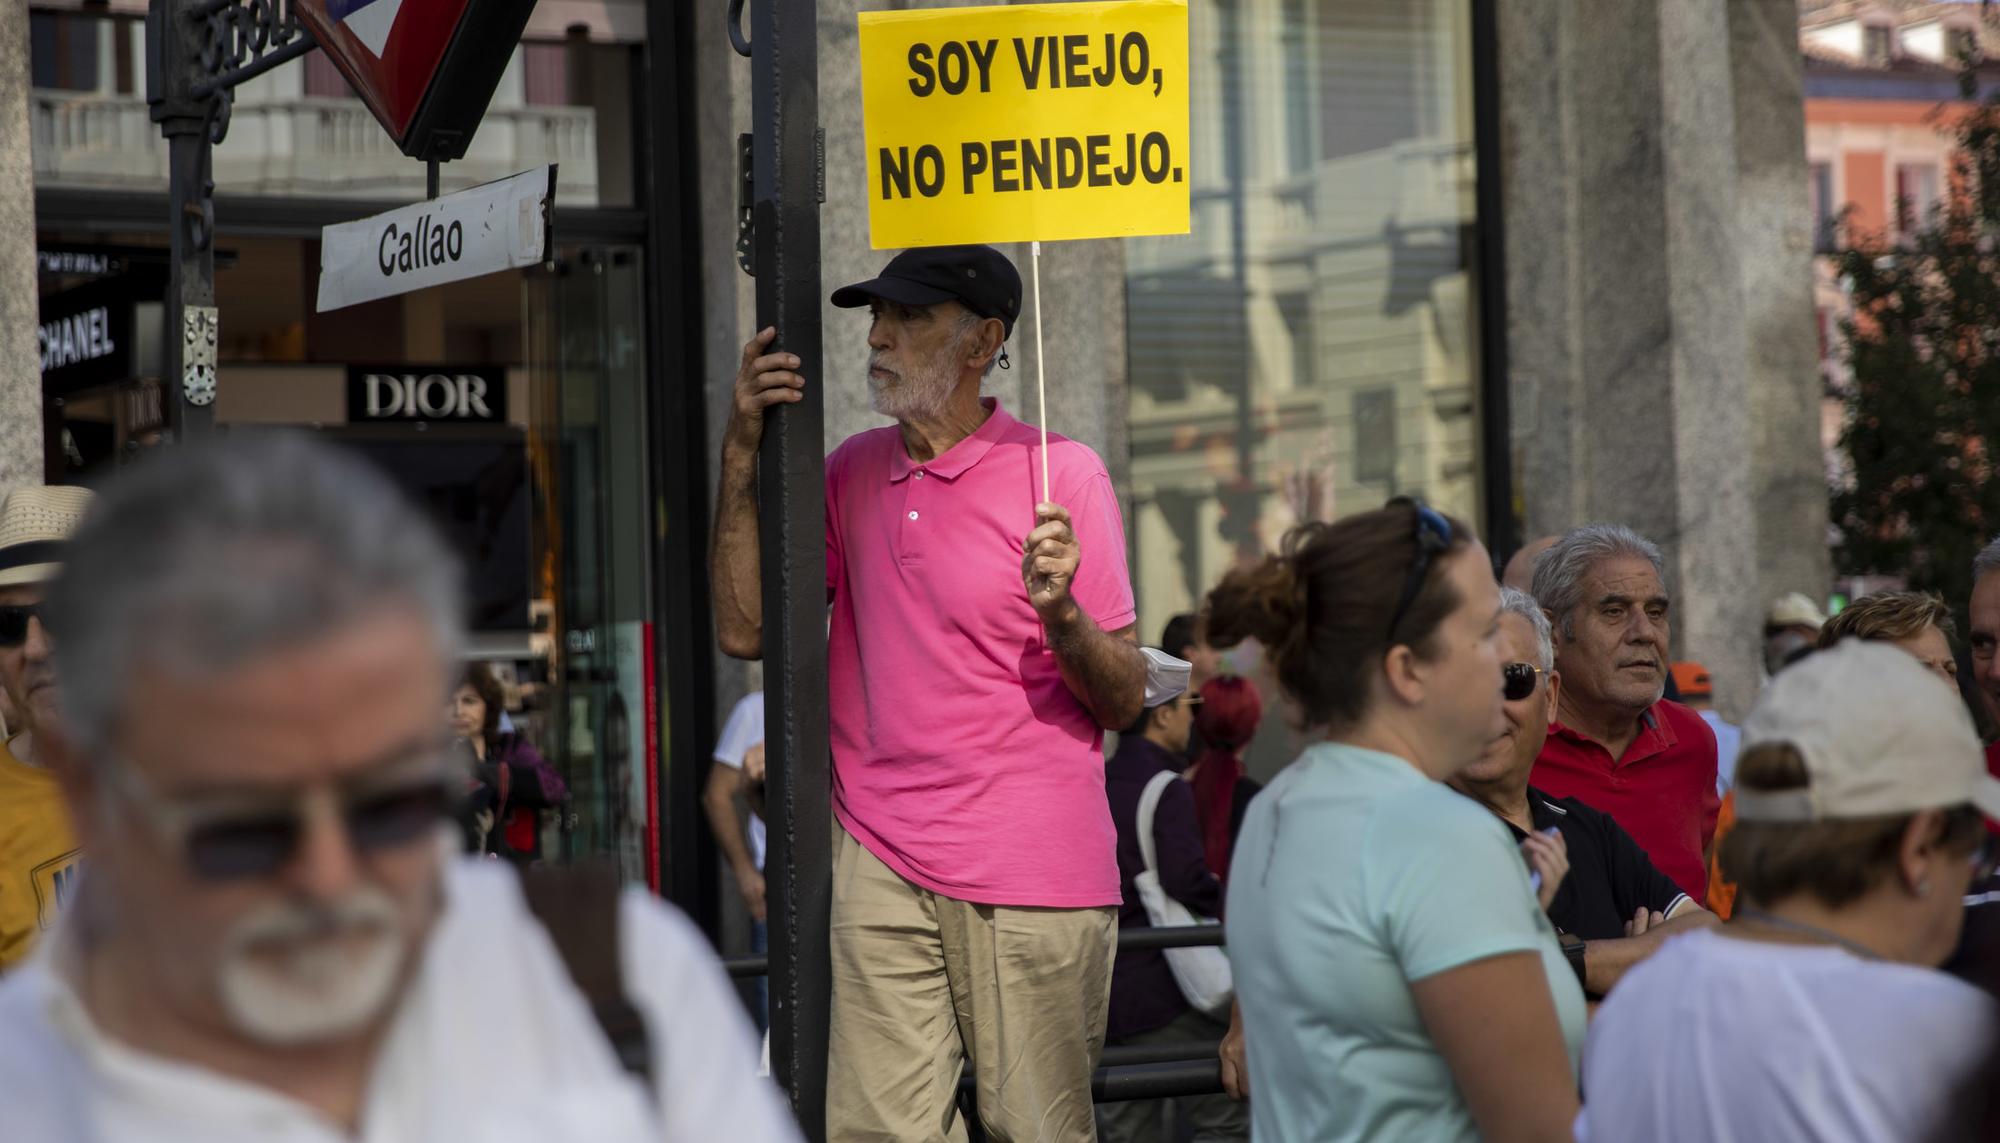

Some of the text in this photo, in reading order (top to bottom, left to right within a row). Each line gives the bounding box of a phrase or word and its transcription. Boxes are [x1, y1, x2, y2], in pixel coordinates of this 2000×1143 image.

[907, 31, 1162, 98] SOY VIEJO,
[879, 131, 1182, 200] NO PENDEJO.
[379, 214, 463, 276] Callao
[364, 374, 491, 419] DIOR
